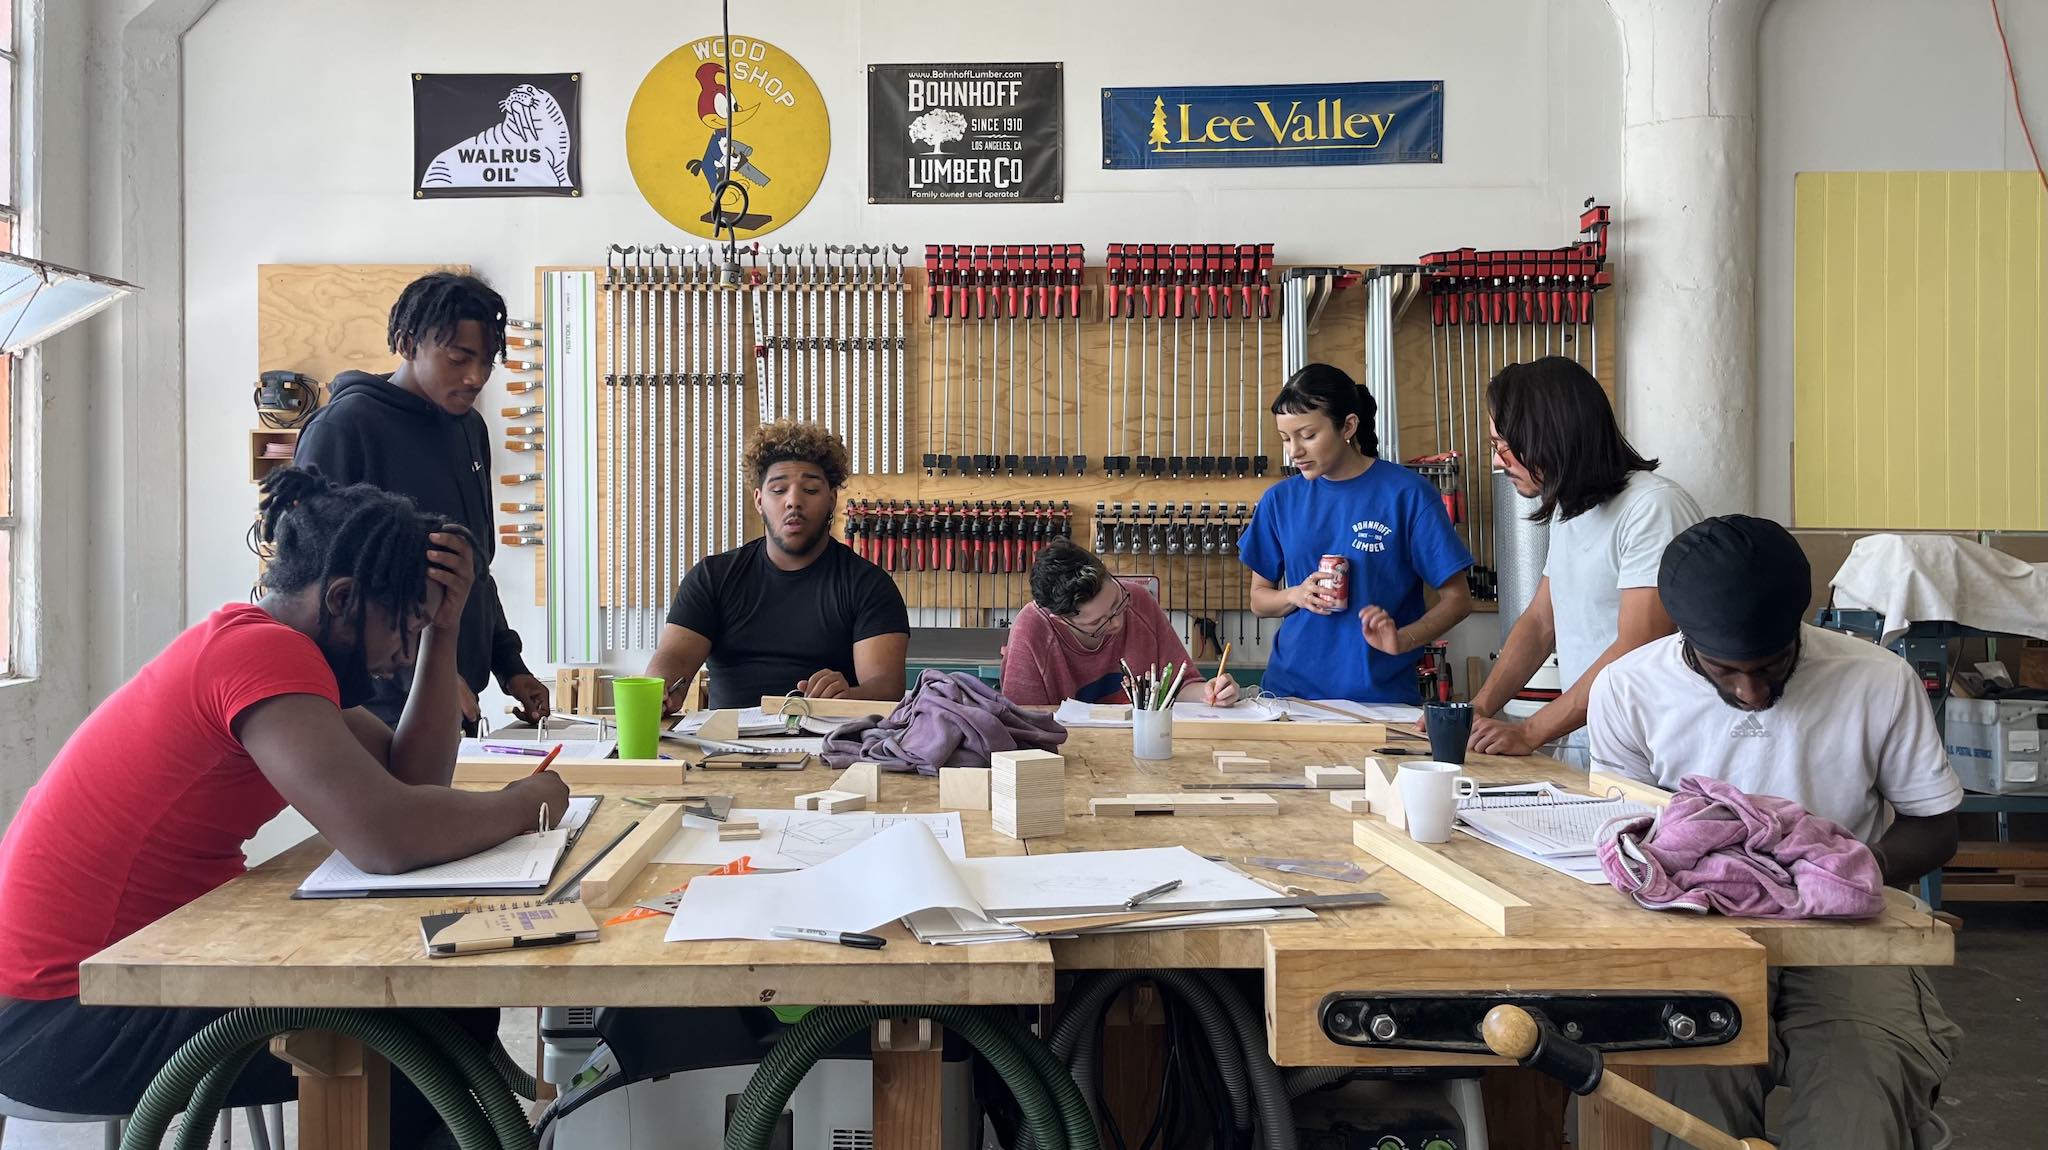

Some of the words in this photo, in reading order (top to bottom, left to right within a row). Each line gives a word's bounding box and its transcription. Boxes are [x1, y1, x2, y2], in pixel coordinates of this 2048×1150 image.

[692, 38, 766, 62] WOOD
[908, 70, 1022, 79] www.BohnhoffLumber.com
[733, 61, 796, 107] SHOP
[908, 79, 1022, 112] BOHNHOFF
[971, 118, 1000, 132] SINCE
[1003, 118, 1023, 132] 1910
[1177, 102, 1256, 144] Lee
[1254, 98, 1396, 148] Valley
[971, 141, 983, 151] LOS
[984, 141, 1012, 151] ANGELES,
[1014, 141, 1022, 151] CA
[458, 149, 541, 163] WALRUS
[911, 190, 938, 199] Family
[940, 190, 965, 198] owned
[967, 190, 983, 198] and
[984, 190, 1019, 199] operated
[1352, 520, 1392, 536] BOHNHOFF
[1352, 538, 1385, 552] LUMBER
[1730, 729, 1772, 738] adidas
